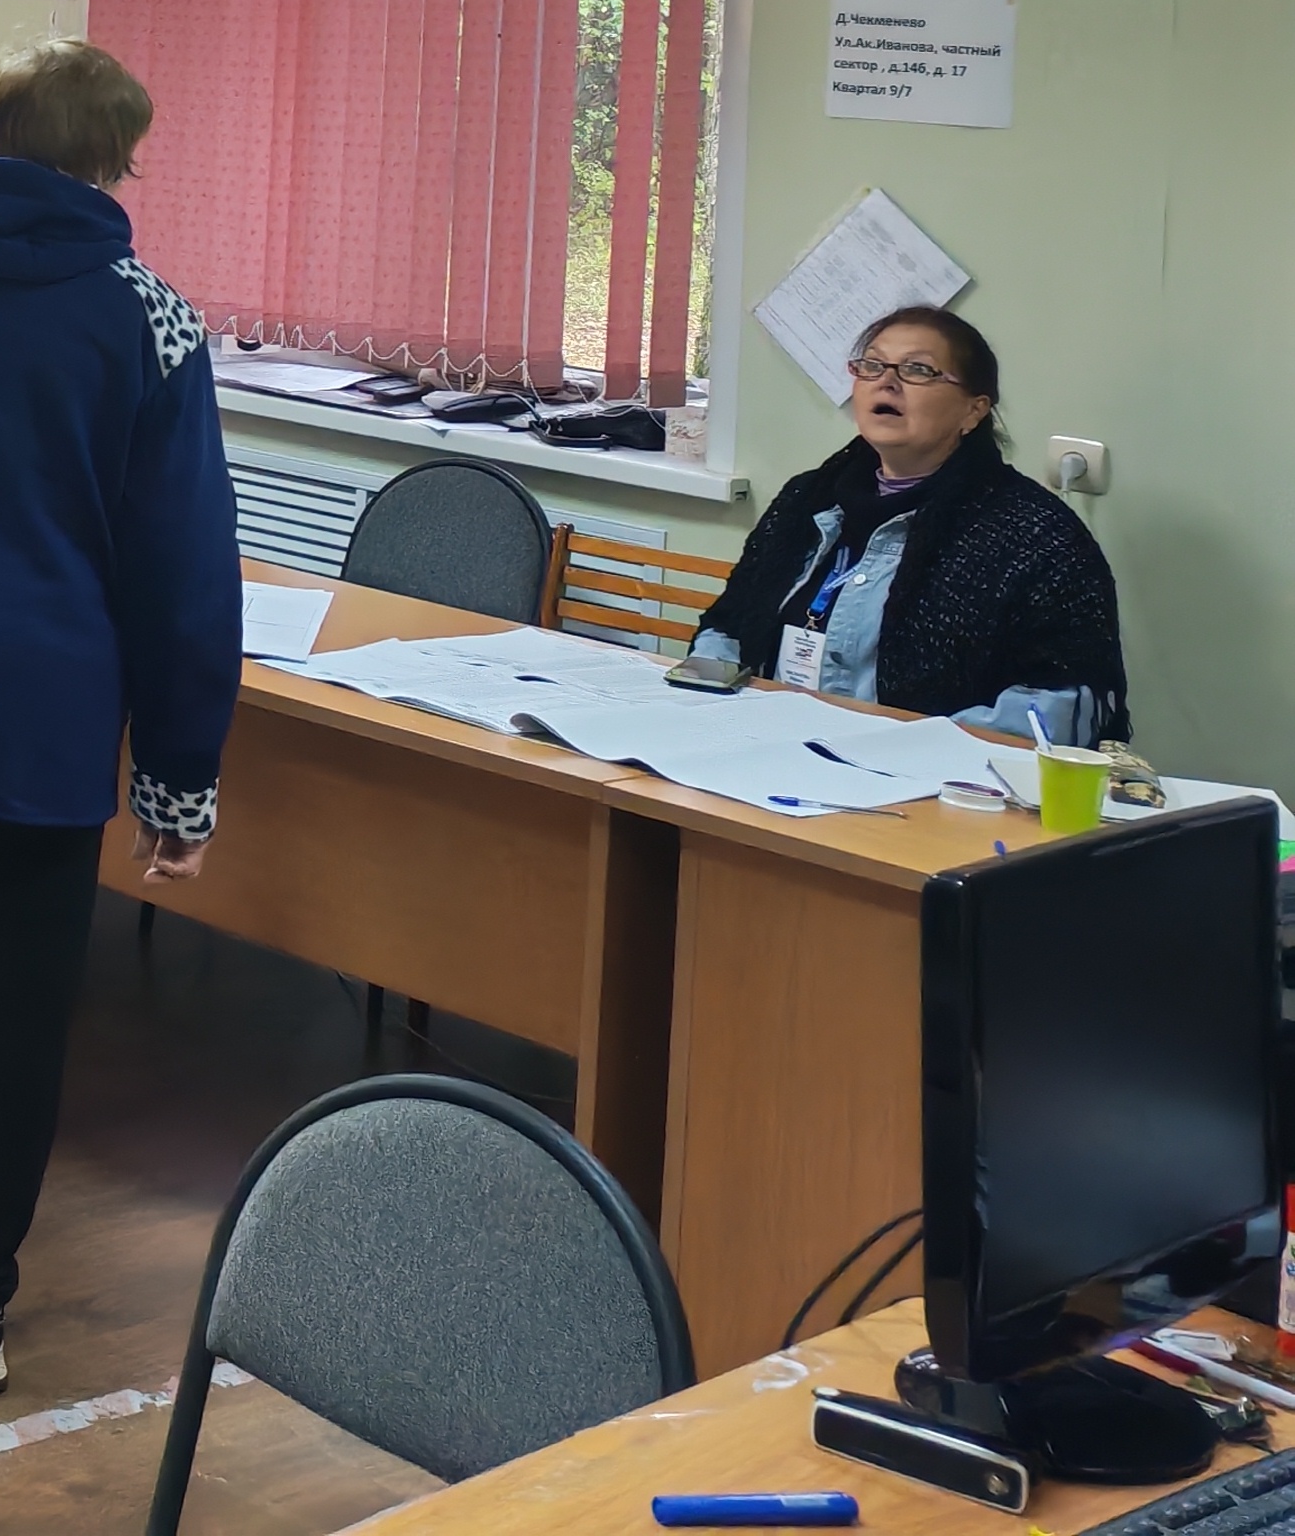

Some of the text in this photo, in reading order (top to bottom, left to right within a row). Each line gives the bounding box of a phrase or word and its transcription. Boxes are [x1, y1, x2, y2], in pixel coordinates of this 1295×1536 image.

[835, 13, 926, 28] Д.Чекменево
[942, 44, 1001, 57] частный
[951, 65, 967, 77] 17
[833, 81, 912, 98] Квартал 9/7
